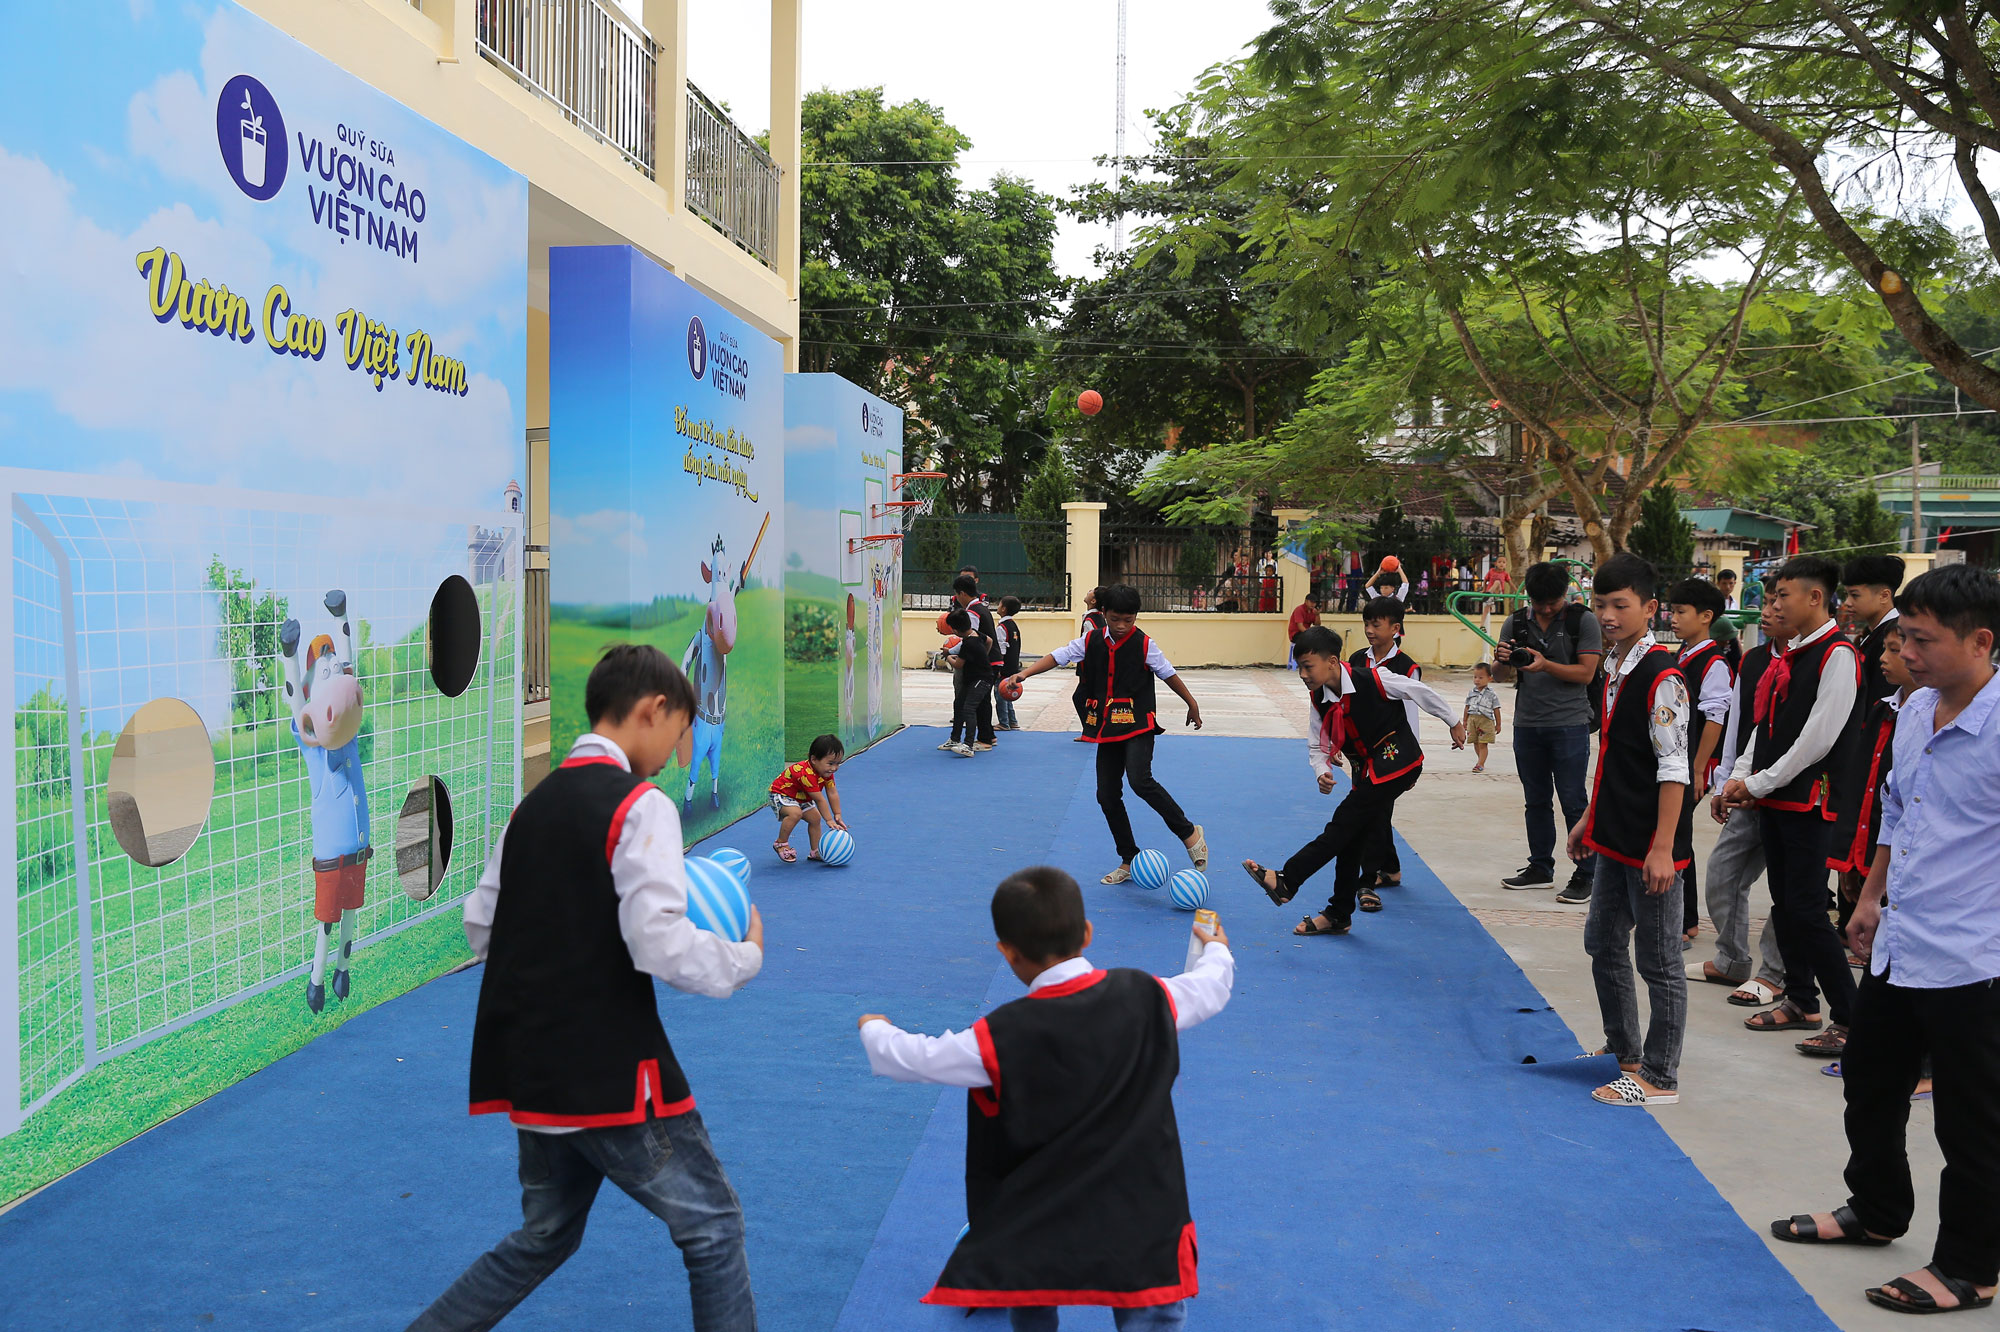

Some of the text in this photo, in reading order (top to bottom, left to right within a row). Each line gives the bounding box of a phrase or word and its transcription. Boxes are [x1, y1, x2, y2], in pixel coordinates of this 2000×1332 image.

[337, 123, 395, 167] QUỸ SỮA
[136, 246, 469, 397] Vươn Cao Việt Nam
